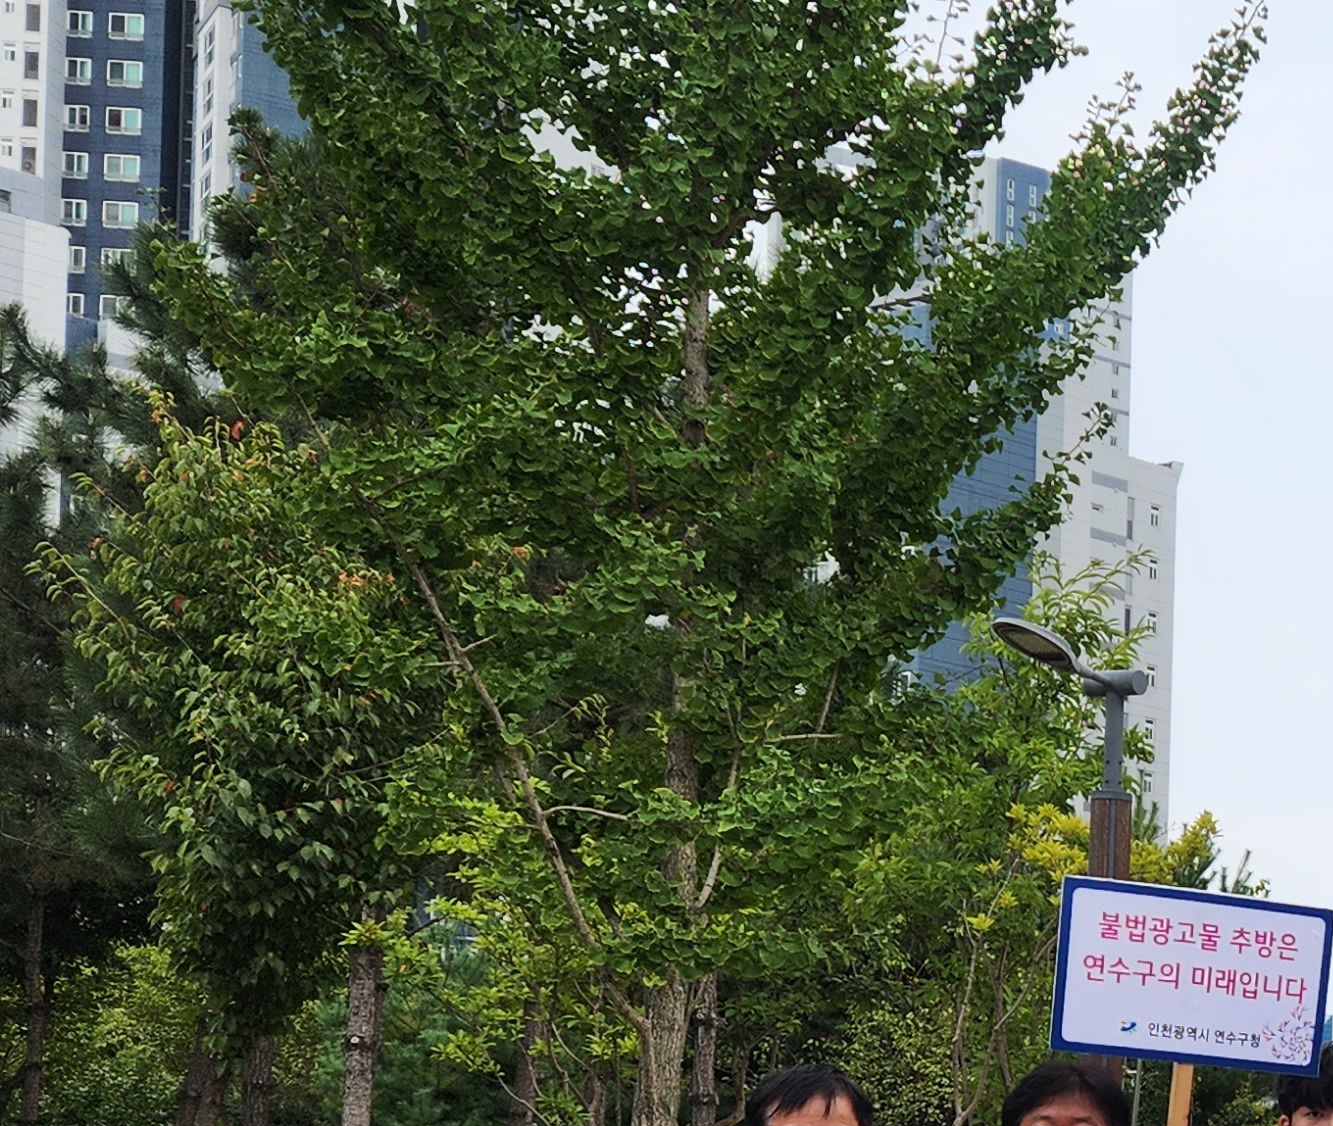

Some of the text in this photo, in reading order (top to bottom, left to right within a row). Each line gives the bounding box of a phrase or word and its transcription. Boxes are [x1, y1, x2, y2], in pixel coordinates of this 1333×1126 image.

[1099, 911, 1298, 961] 불법광고물 추방은
[1083, 955, 1307, 1004] 연수구의 미래입니다
[1148, 1022, 1261, 1048] 인천광역시 연수구청
